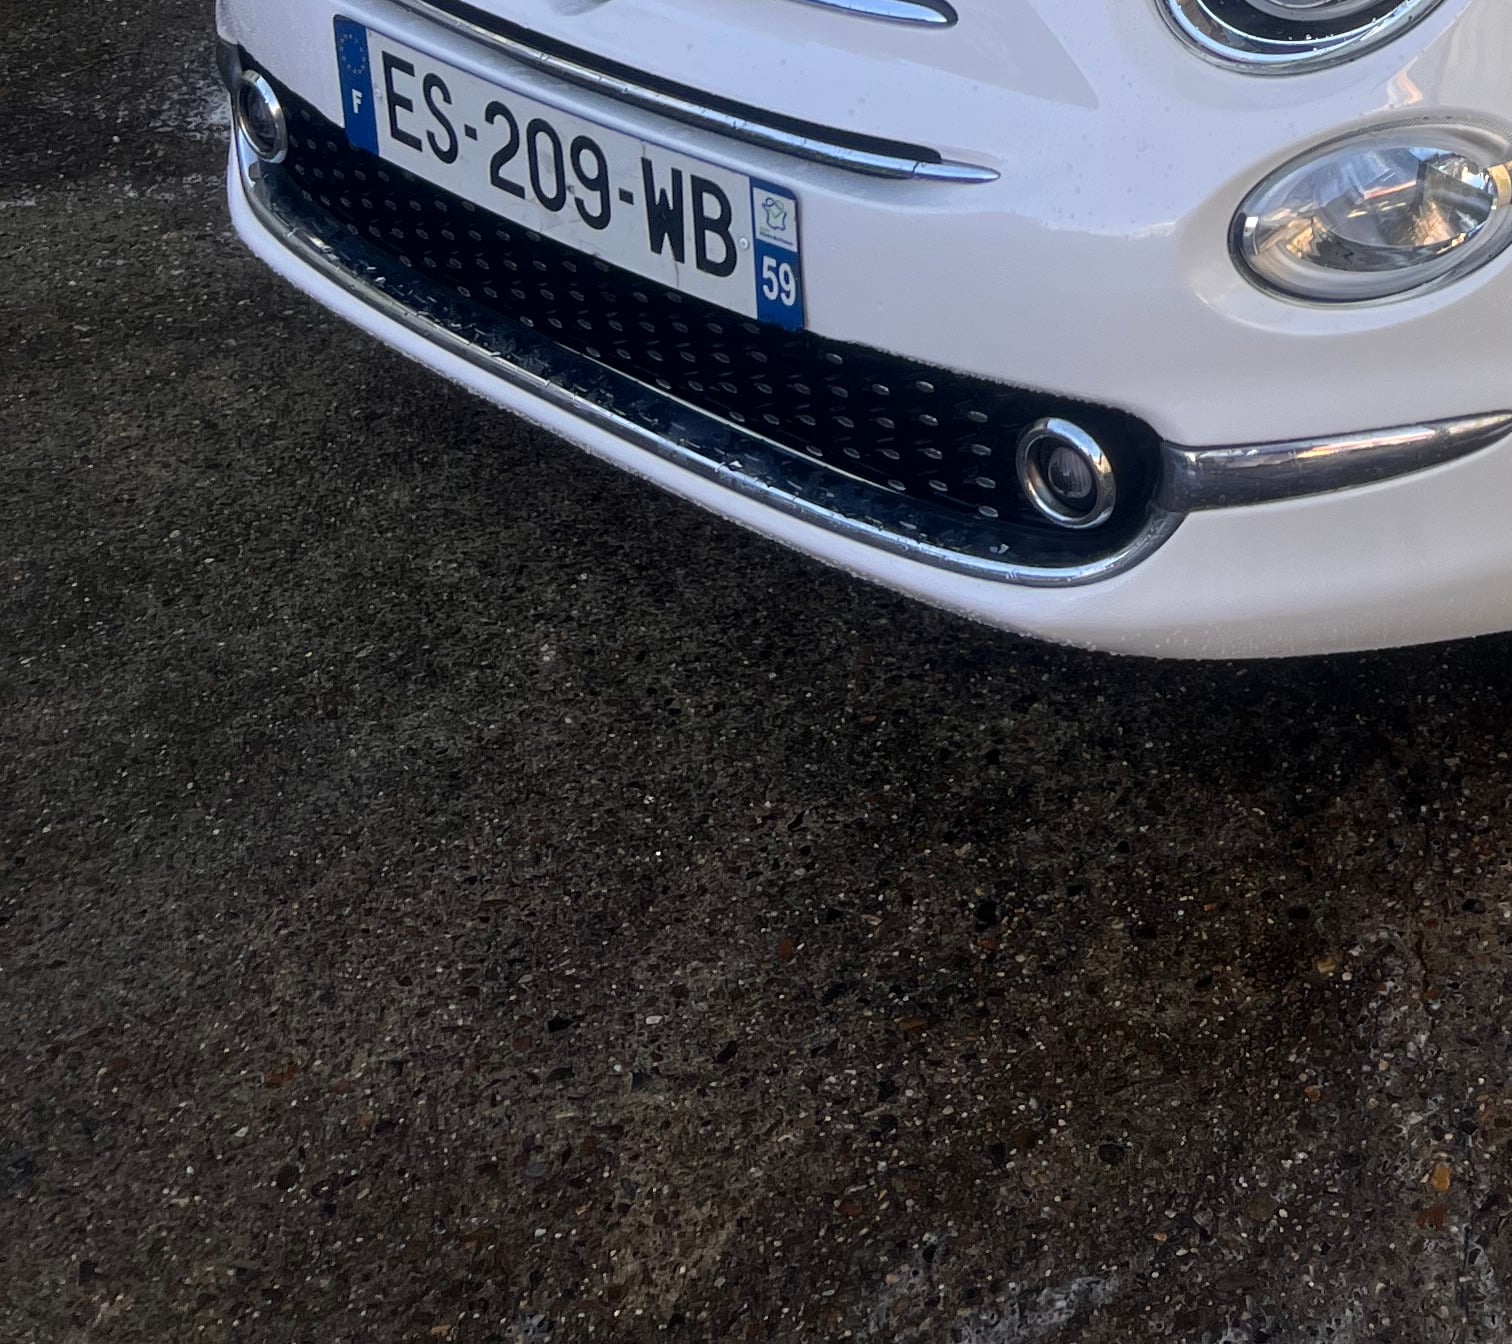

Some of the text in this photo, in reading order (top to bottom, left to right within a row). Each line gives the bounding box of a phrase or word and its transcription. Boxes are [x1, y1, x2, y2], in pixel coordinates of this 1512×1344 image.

[352, 88, 363, 114] F
[381, 50, 737, 278] ES-209-WB
[762, 255, 796, 306] 59
